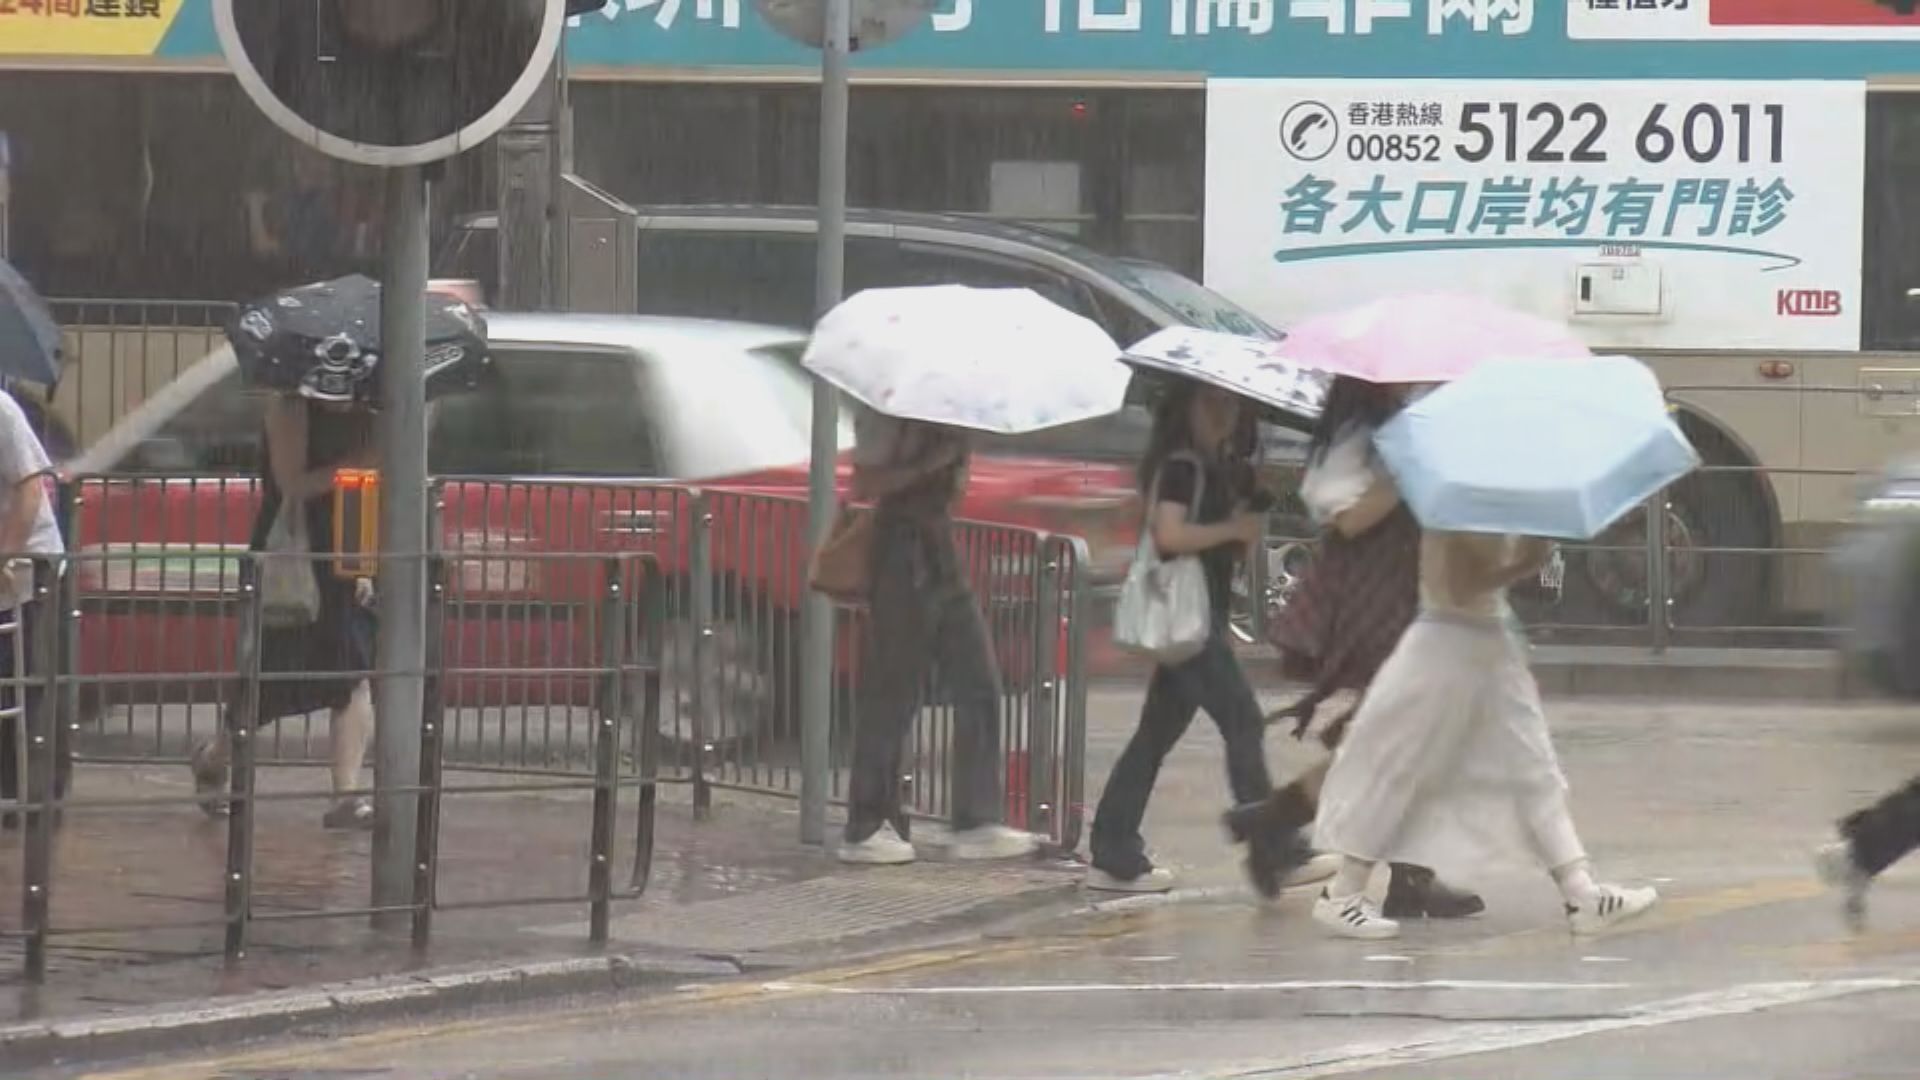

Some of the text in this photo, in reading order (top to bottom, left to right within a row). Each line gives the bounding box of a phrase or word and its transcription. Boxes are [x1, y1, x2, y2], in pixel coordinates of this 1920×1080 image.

[1347, 102, 1444, 126] 香港熱線
[1454, 102, 1785, 164] 5122 6011
[1347, 134, 1441, 162] 00852
[1279, 174, 1796, 237] 各大口岸均有門診
[1777, 289, 1842, 316] KMB
